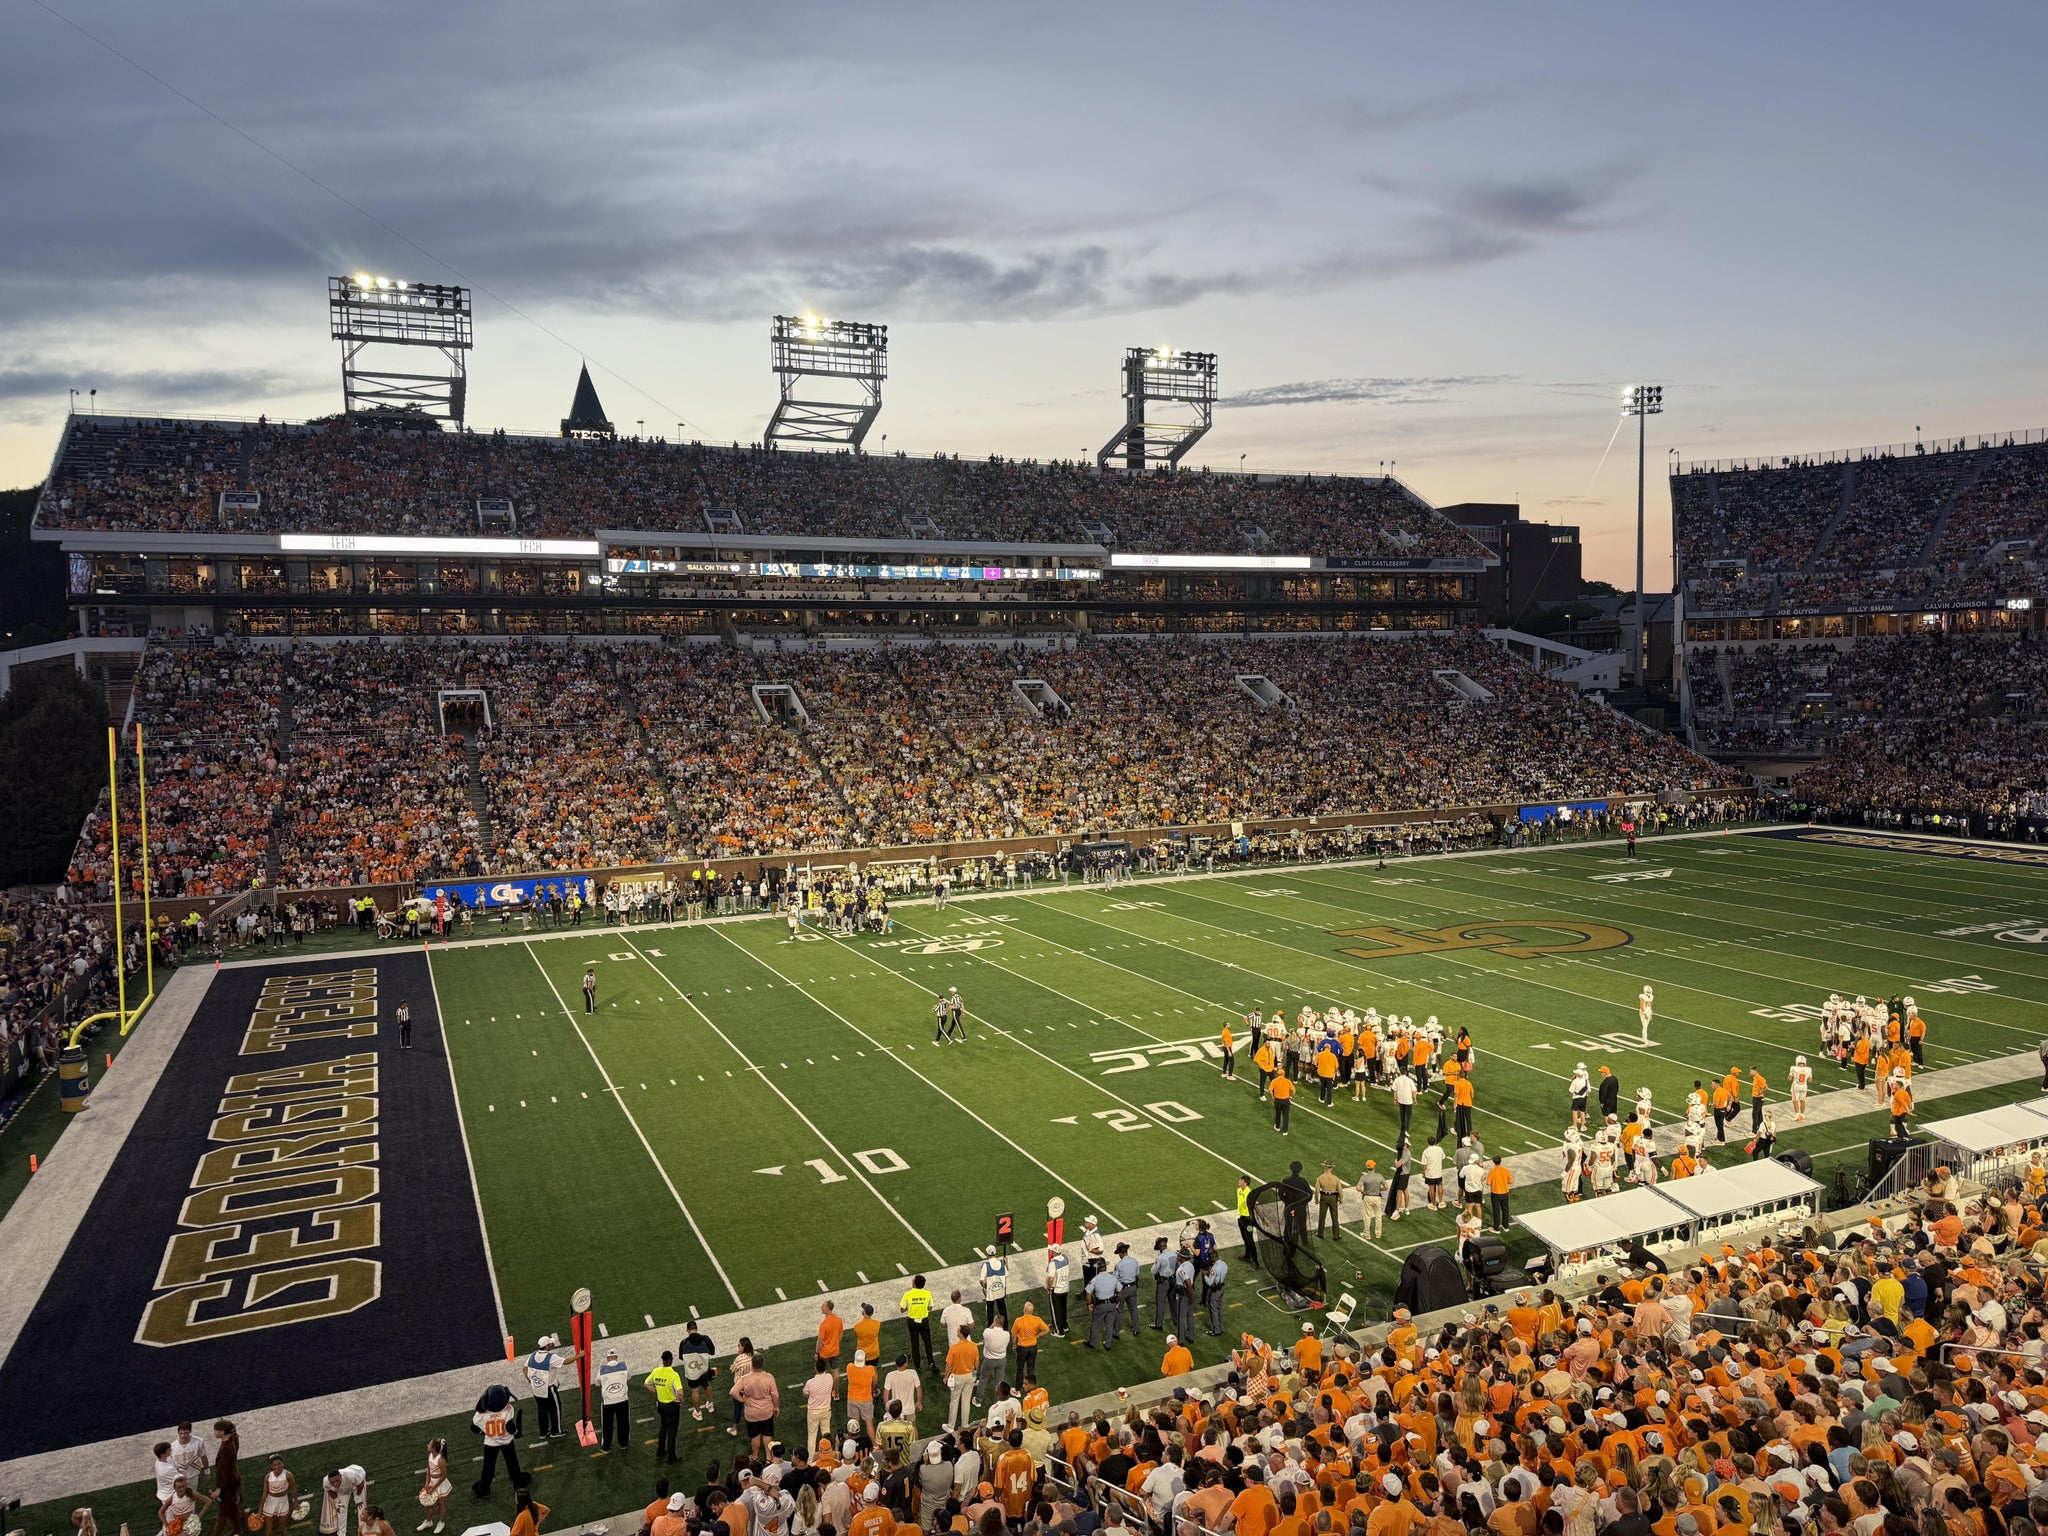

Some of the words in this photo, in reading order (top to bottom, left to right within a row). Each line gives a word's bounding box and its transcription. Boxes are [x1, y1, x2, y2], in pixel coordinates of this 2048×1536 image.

[331, 536, 356, 549] TECH
[519, 540, 543, 553] TECH
[766, 563, 779, 572] 10
[1924, 602, 1950, 610] CALVIN
[1951, 601, 1987, 609] JOHNSON
[490, 883, 524, 903] GT
[867, 930, 1004, 949] HYUNDAI
[607, 948, 668, 961] 10
[238, 967, 378, 1056] TECH
[1747, 1003, 1824, 1023] 50
[1560, 1032, 1663, 1054] 40
[1091, 1100, 1206, 1133] 20
[803, 1147, 912, 1185] 10
[1599, 1150, 1613, 1163] 55
[133, 1051, 382, 1348] GEORGIA
[998, 1216, 1012, 1235] 2
[484, 1418, 506, 1439] 00
[886, 1435, 905, 1452] 15
[1949, 1436, 1969, 1455] T
[903, 1476, 911, 1498] 1
[1009, 1471, 1029, 1495] 14
